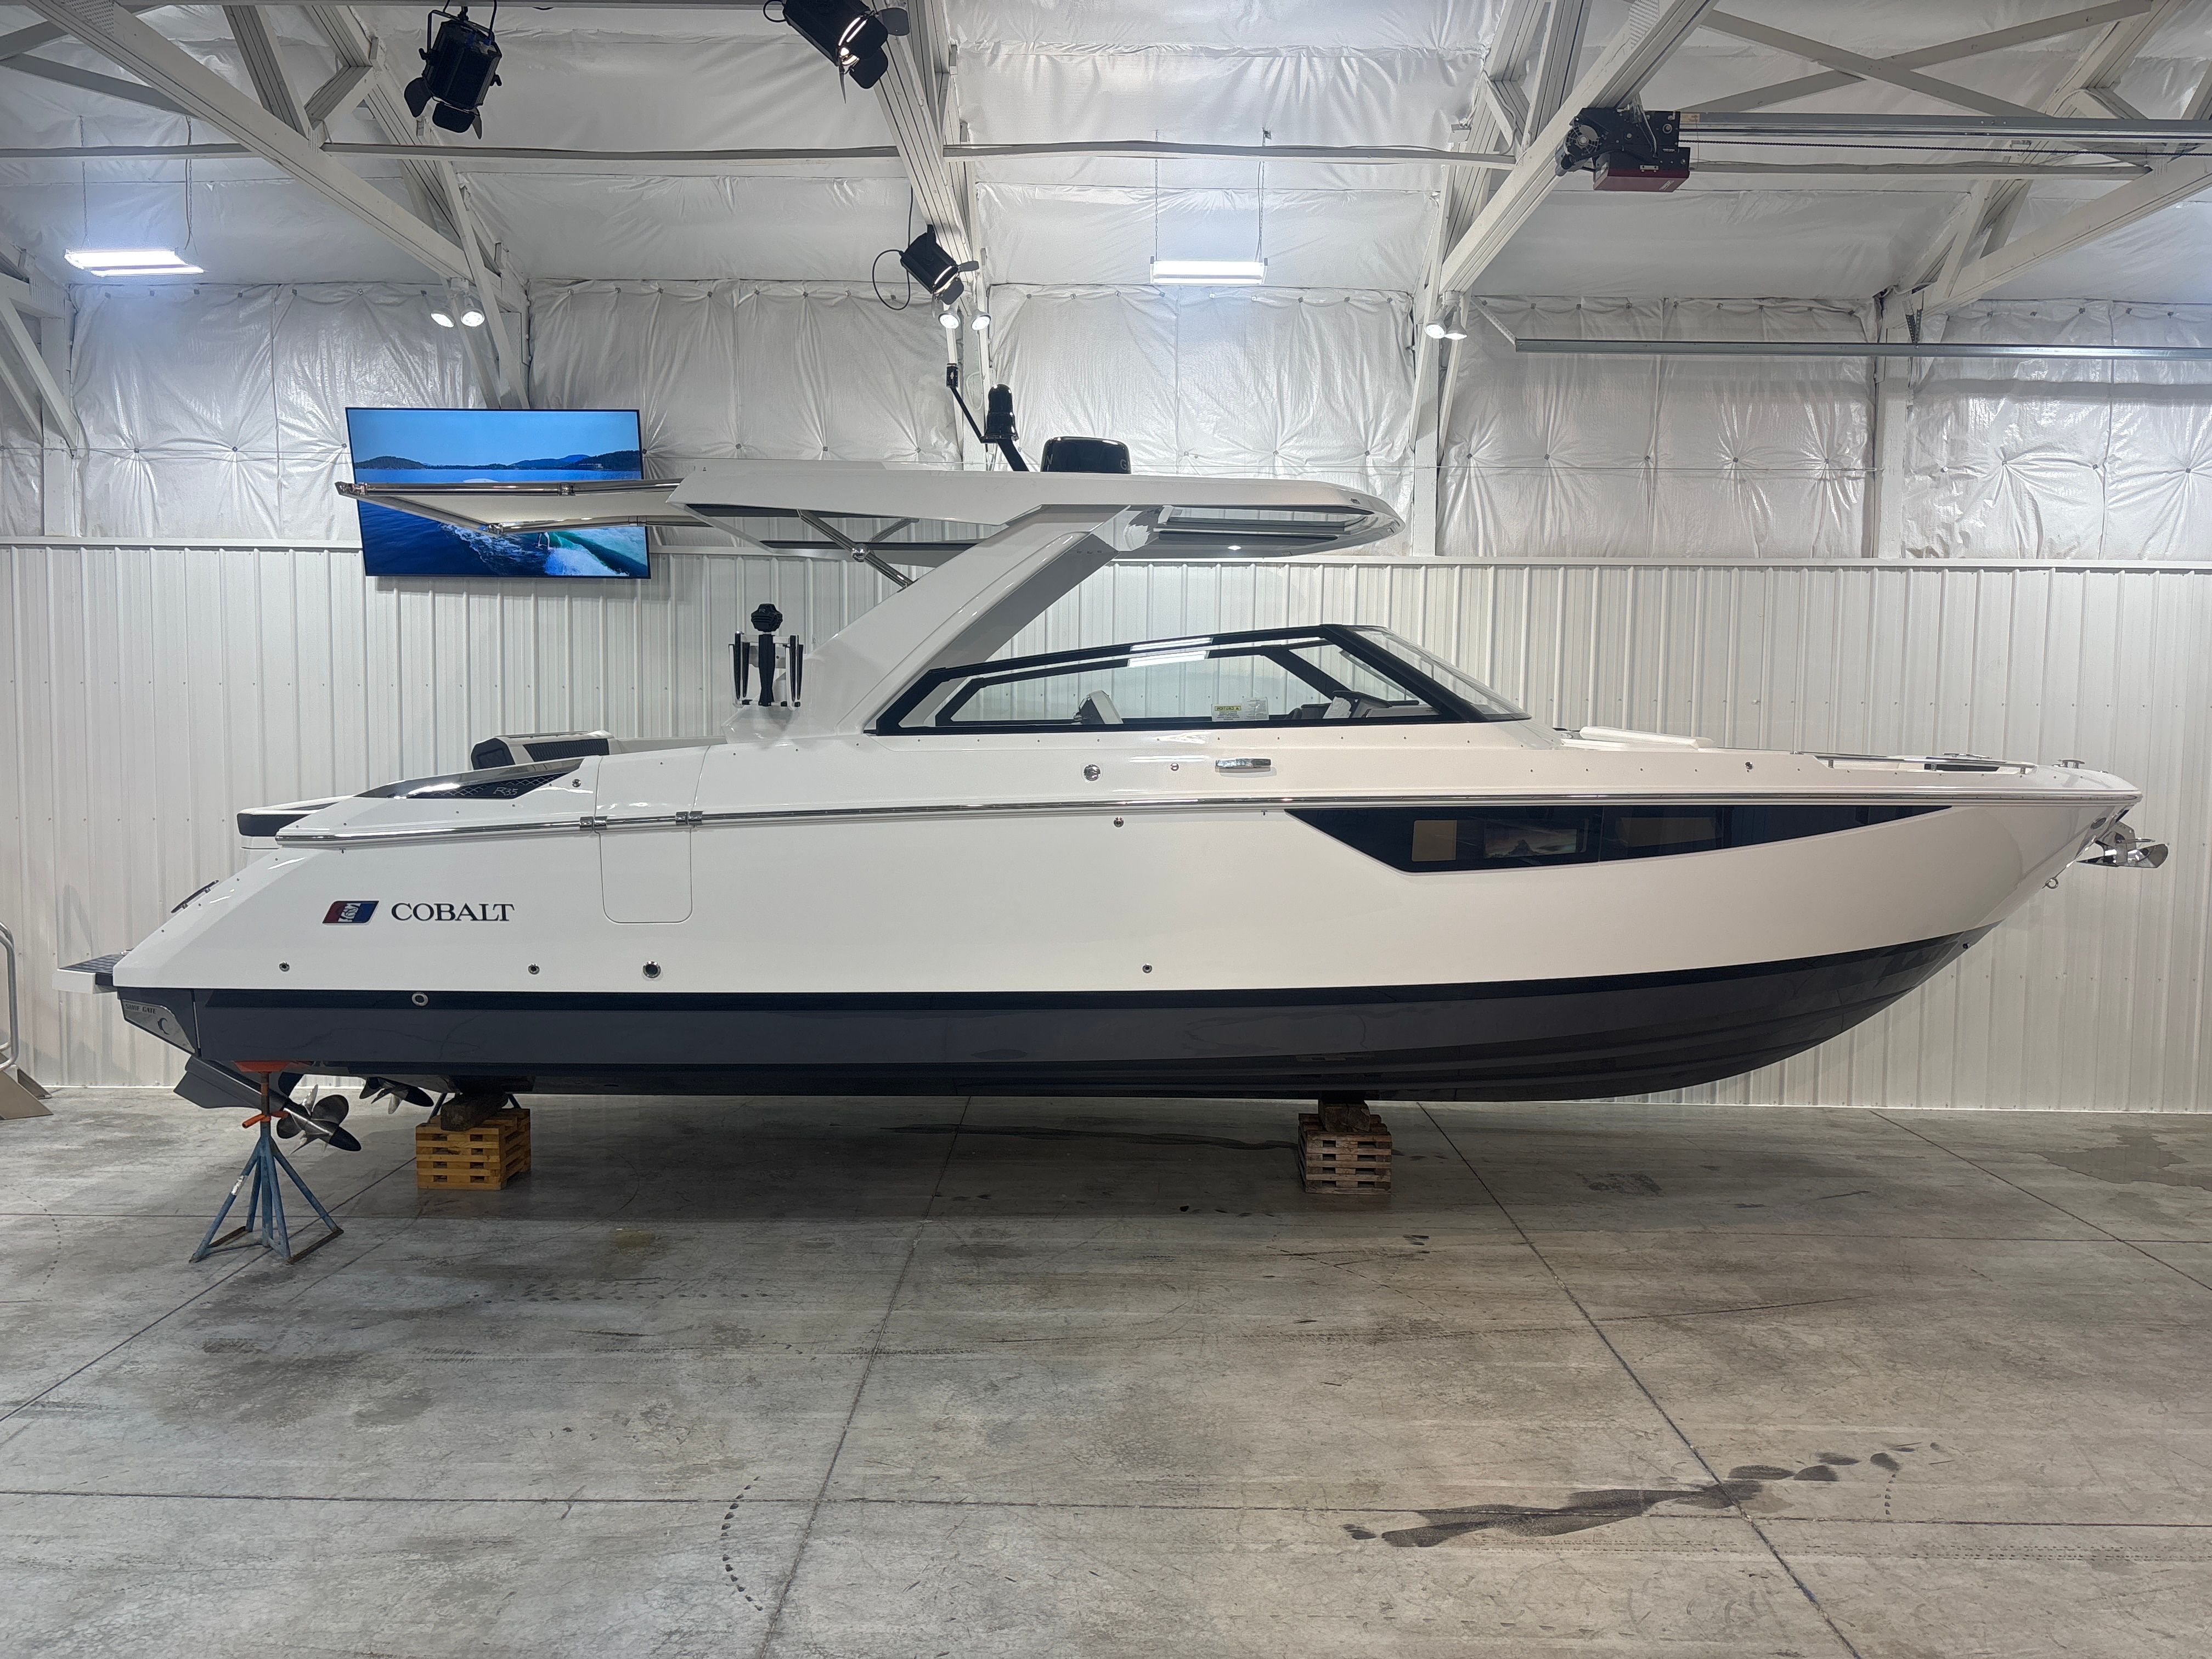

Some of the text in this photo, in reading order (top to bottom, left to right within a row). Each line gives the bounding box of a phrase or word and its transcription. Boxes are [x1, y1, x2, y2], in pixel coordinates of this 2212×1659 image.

[493, 787, 518, 795] R35
[391, 902, 515, 921] COBALT
[142, 1006, 156, 1014] GATE
